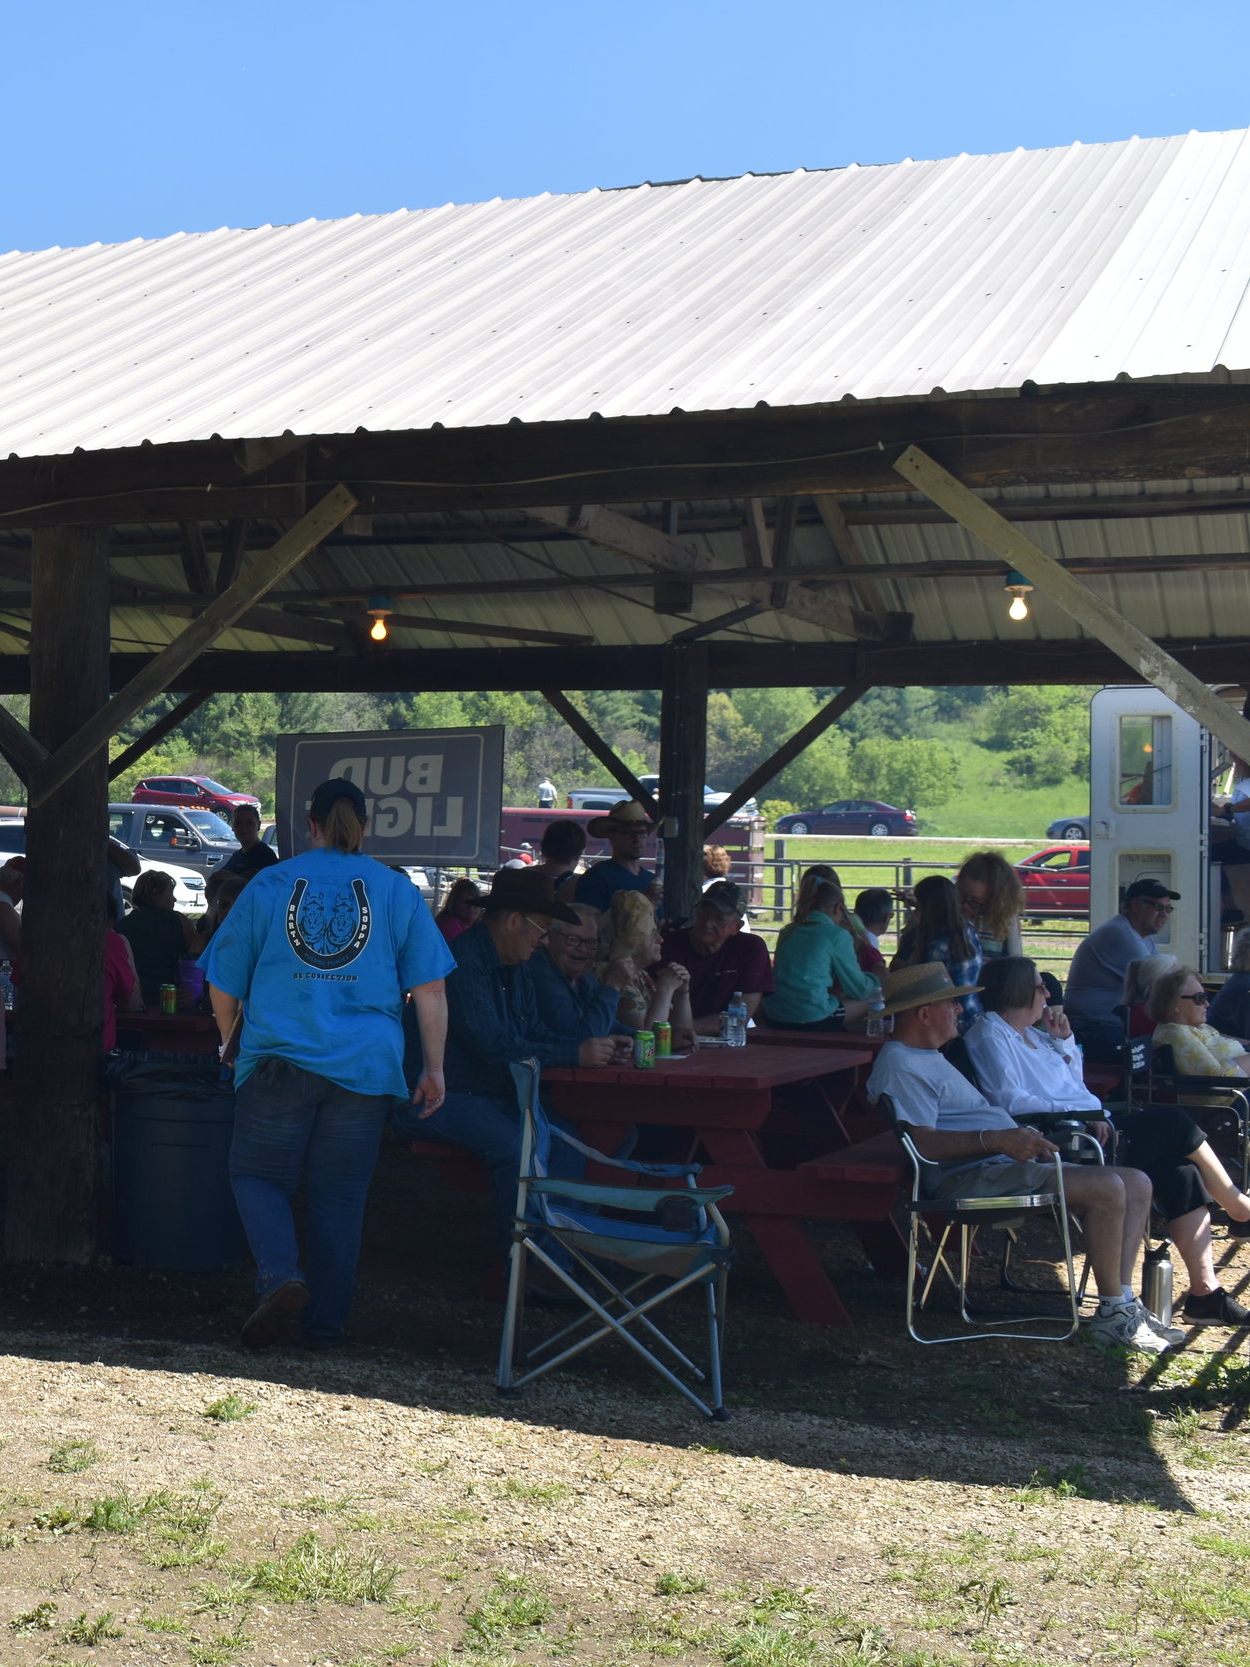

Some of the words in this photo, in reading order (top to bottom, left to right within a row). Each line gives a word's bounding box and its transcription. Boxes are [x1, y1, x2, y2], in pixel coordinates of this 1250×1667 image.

[288, 904, 301, 947] BARTZ
[353, 906, 368, 949] SOPPA
[305, 973, 358, 983] CONNECTION
